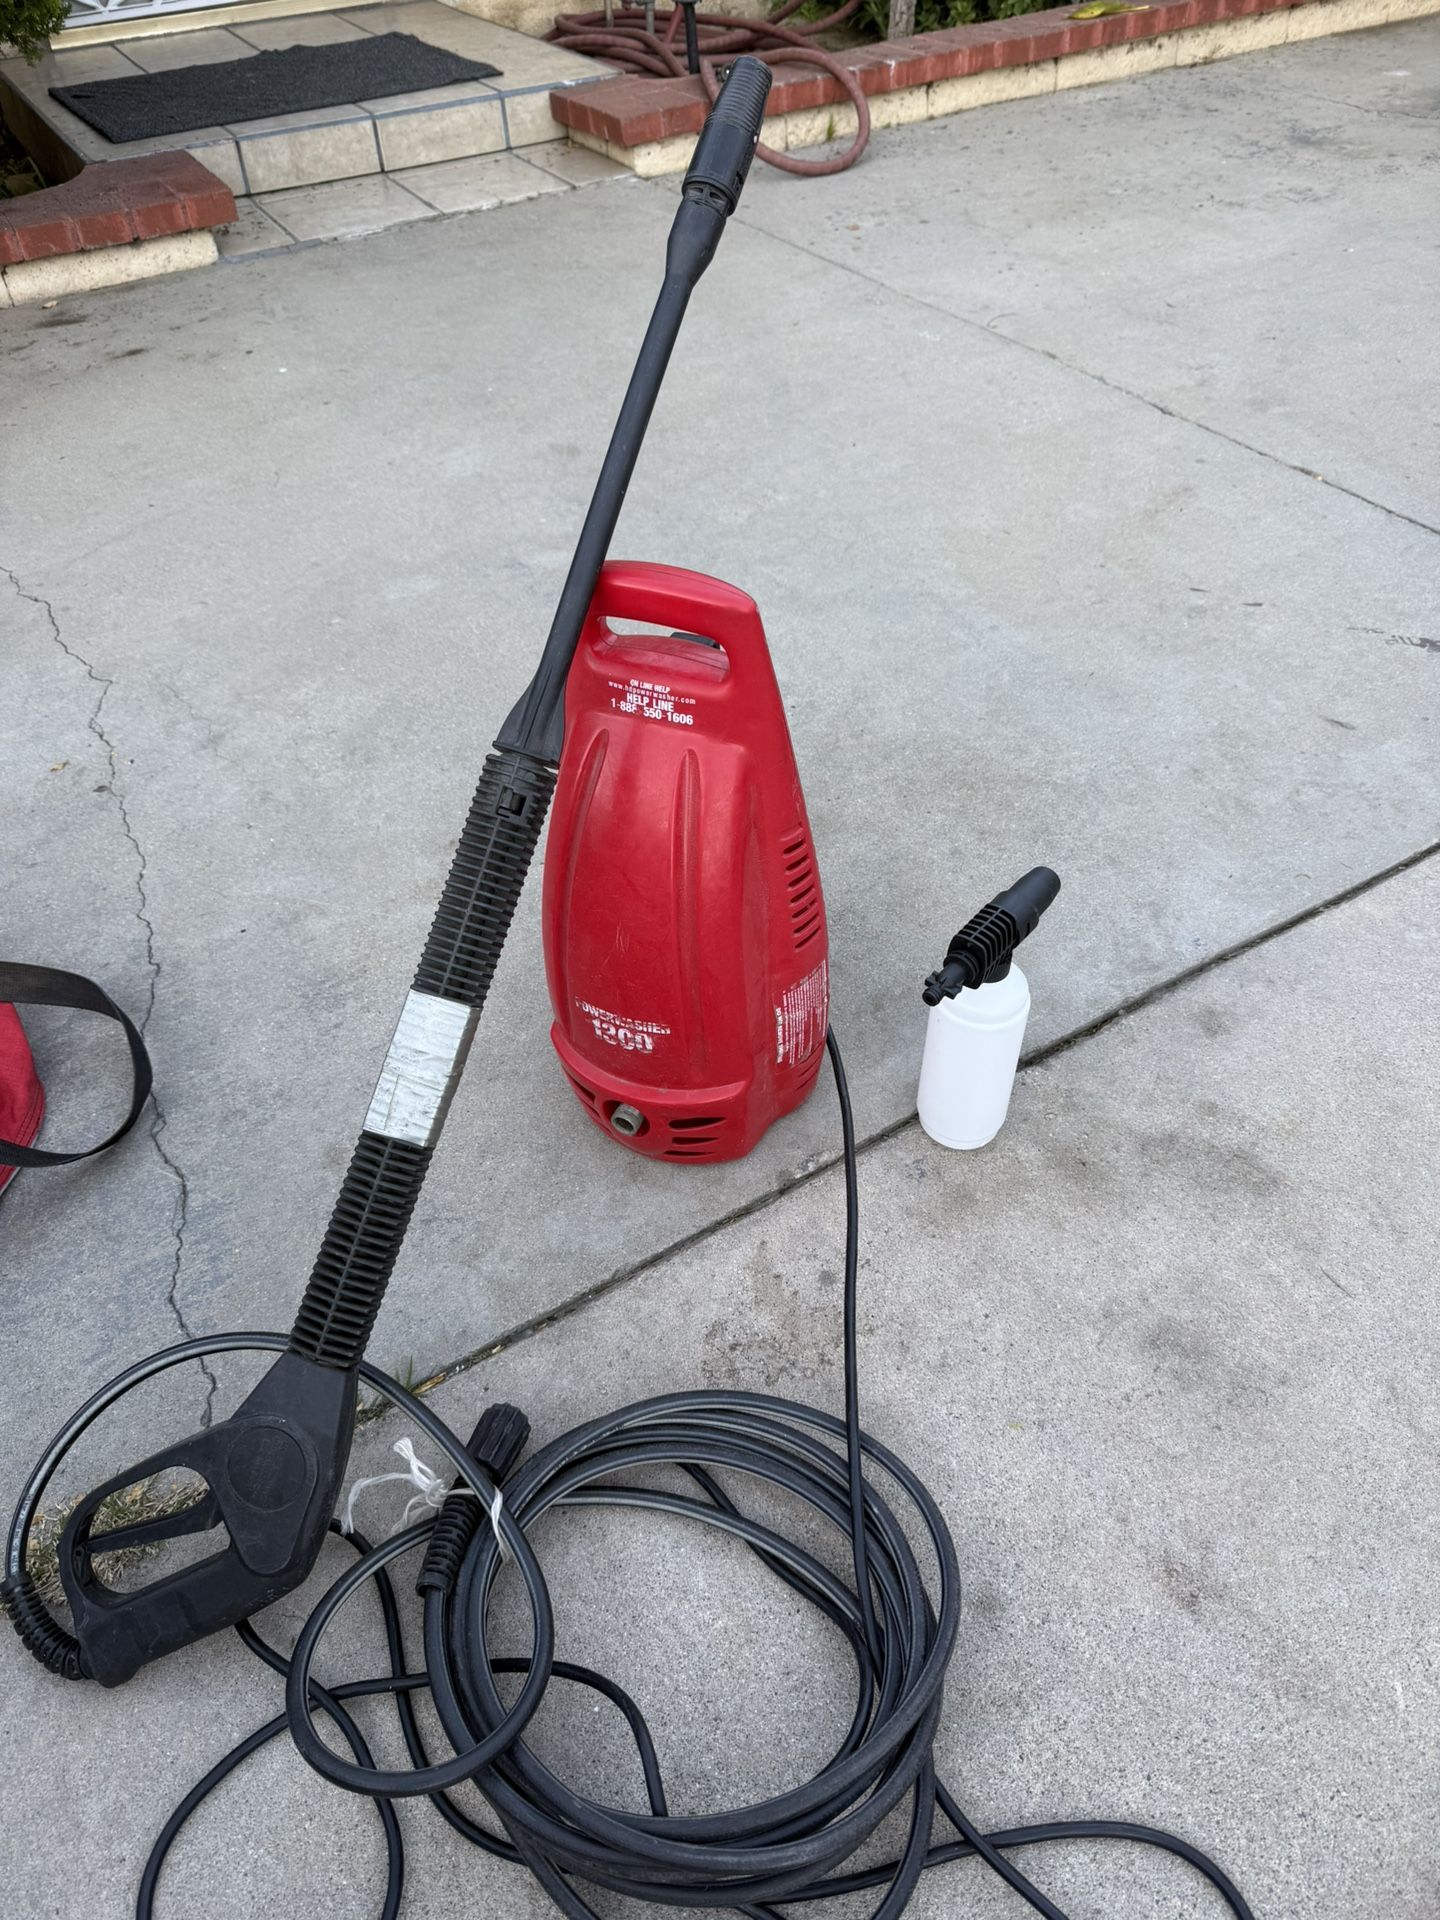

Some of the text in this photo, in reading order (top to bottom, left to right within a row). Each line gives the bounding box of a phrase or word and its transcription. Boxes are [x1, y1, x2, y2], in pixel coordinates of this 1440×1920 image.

[630, 679, 670, 693] ON LINE HELP
[611, 697, 693, 725] 1-88550-1606
[627, 692, 675, 713] HELP LINE
